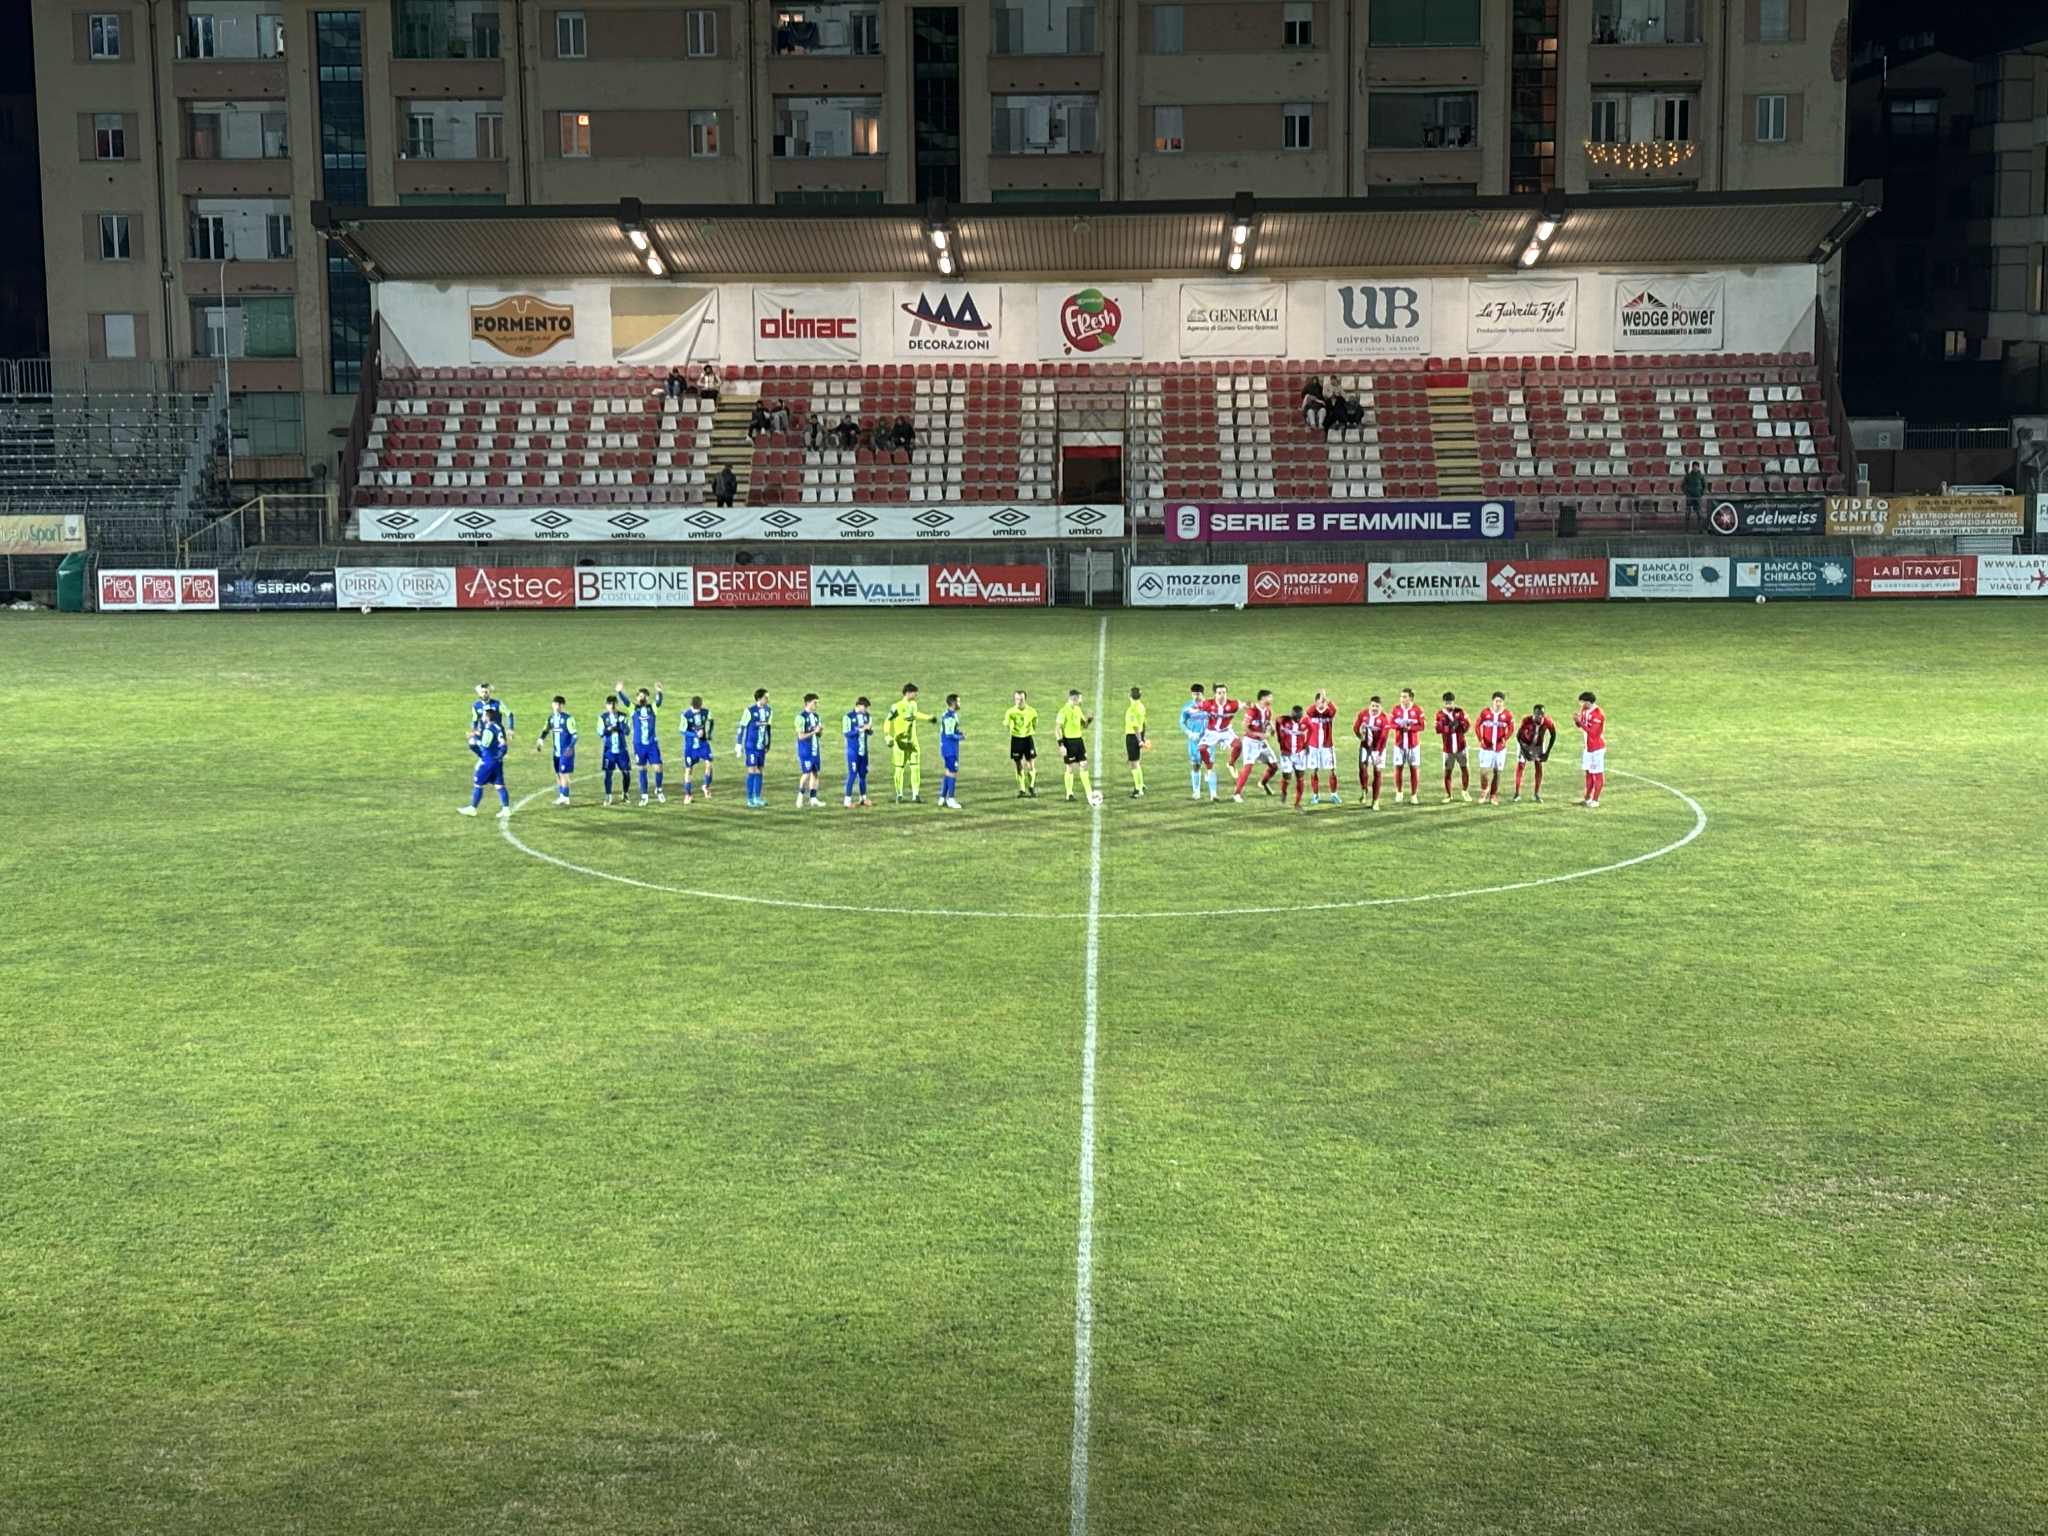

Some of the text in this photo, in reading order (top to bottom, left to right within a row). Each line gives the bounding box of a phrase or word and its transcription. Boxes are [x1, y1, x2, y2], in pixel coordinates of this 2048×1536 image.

[1337, 286, 1420, 329] UB
[1208, 308, 1279, 322] GENERALI
[474, 316, 572, 332] FORMENTO
[760, 309, 857, 339] olimac
[1336, 333, 1420, 344] universo bianco
[909, 339, 989, 350] DECORAZIONI
[1830, 499, 1889, 511] VIDEO
[1210, 512, 1471, 531] SERIE B FEMMINILE
[1746, 512, 1818, 525] edelweiss
[1829, 511, 1888, 523] CENTER
[381, 532, 416, 540] umbro
[458, 531, 492, 539] umbro
[535, 531, 569, 539] umbro
[611, 531, 645, 539] umbro
[688, 530, 722, 539] umbro
[764, 530, 798, 538] umbro
[840, 530, 875, 538] umbro
[916, 529, 951, 538] umbro
[992, 528, 1027, 536] umbro
[1068, 527, 1103, 536] umbro
[1642, 563, 1690, 572] BANCA DI
[1764, 562, 1812, 571] BANCA DI
[1873, 565, 1959, 576] LAB TRAVEL
[1166, 573, 1241, 585] mozzone
[1283, 571, 1359, 584] mozzone
[1514, 573, 1599, 588] CEMENTAL
[1641, 572, 1694, 582] CHERASCO
[1764, 571, 1817, 582] CHERASCO
[257, 582, 311, 594] SERENO
[345, 578, 388, 591] PIRRA
[402, 578, 446, 591] PIRRA
[465, 568, 563, 598] Astec
[579, 572, 689, 601] BERTONE
[697, 571, 808, 601] BERTONE
[1396, 576, 1481, 589] CEMENTAL
[1990, 583, 2023, 591] VIAGGI
[1166, 585, 1204, 596] fratelli
[1284, 584, 1321, 595] fratelli
[601, 590, 689, 601] costruzioni edili
[719, 590, 809, 601] costruzioni edili
